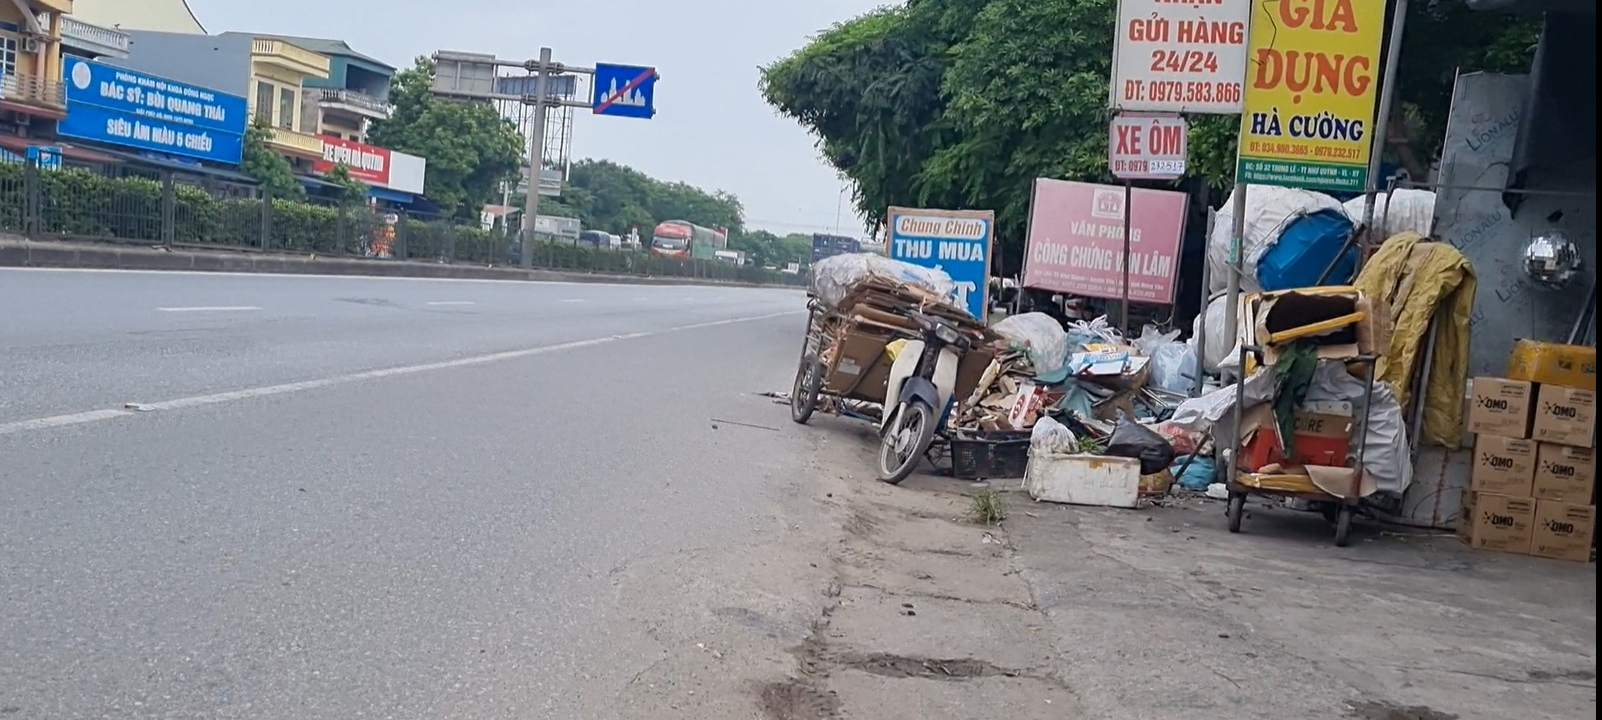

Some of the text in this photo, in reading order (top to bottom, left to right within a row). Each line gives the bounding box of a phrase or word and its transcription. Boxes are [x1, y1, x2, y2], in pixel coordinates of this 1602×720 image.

[1129, 11, 1244, 44] GỬI HÀNG
[1151, 50, 1218, 72] 24/24
[1253, 48, 1371, 104] DỤNG
[100, 81, 124, 100] BÁC
[127, 86, 145, 105] SỸ:
[147, 91, 165, 109] BÙI
[167, 98, 201, 117] QUANG
[204, 103, 225, 121] THÁI
[1125, 79, 1241, 103] ĐT: 0979.583.866
[107, 118, 131, 138] SIÊU
[133, 121, 150, 142] ÂM
[152, 125, 176, 144] MÀU
[176, 132, 183, 147] 5
[1250, 107, 1364, 141] HÀ CƯỜNG
[1115, 119, 1182, 155] XE ÔM
[323, 143, 334, 162] XE
[1129, 160, 1148, 171] 0979
[901, 218, 941, 235] Chung
[1071, 221, 1096, 237] VĂN
[895, 239, 984, 262] THU MUA
[1034, 238, 1068, 266] CÔNG
[1070, 242, 1113, 271] CHỨNG
[1142, 250, 1171, 278] LÂM
[1485, 398, 1508, 410] OMO
[1553, 405, 1576, 418] OMO
[1491, 456, 1513, 469] OMO
[1551, 464, 1575, 476] OMO
[1492, 515, 1514, 527] OMO
[1551, 522, 1574, 534] OMO
